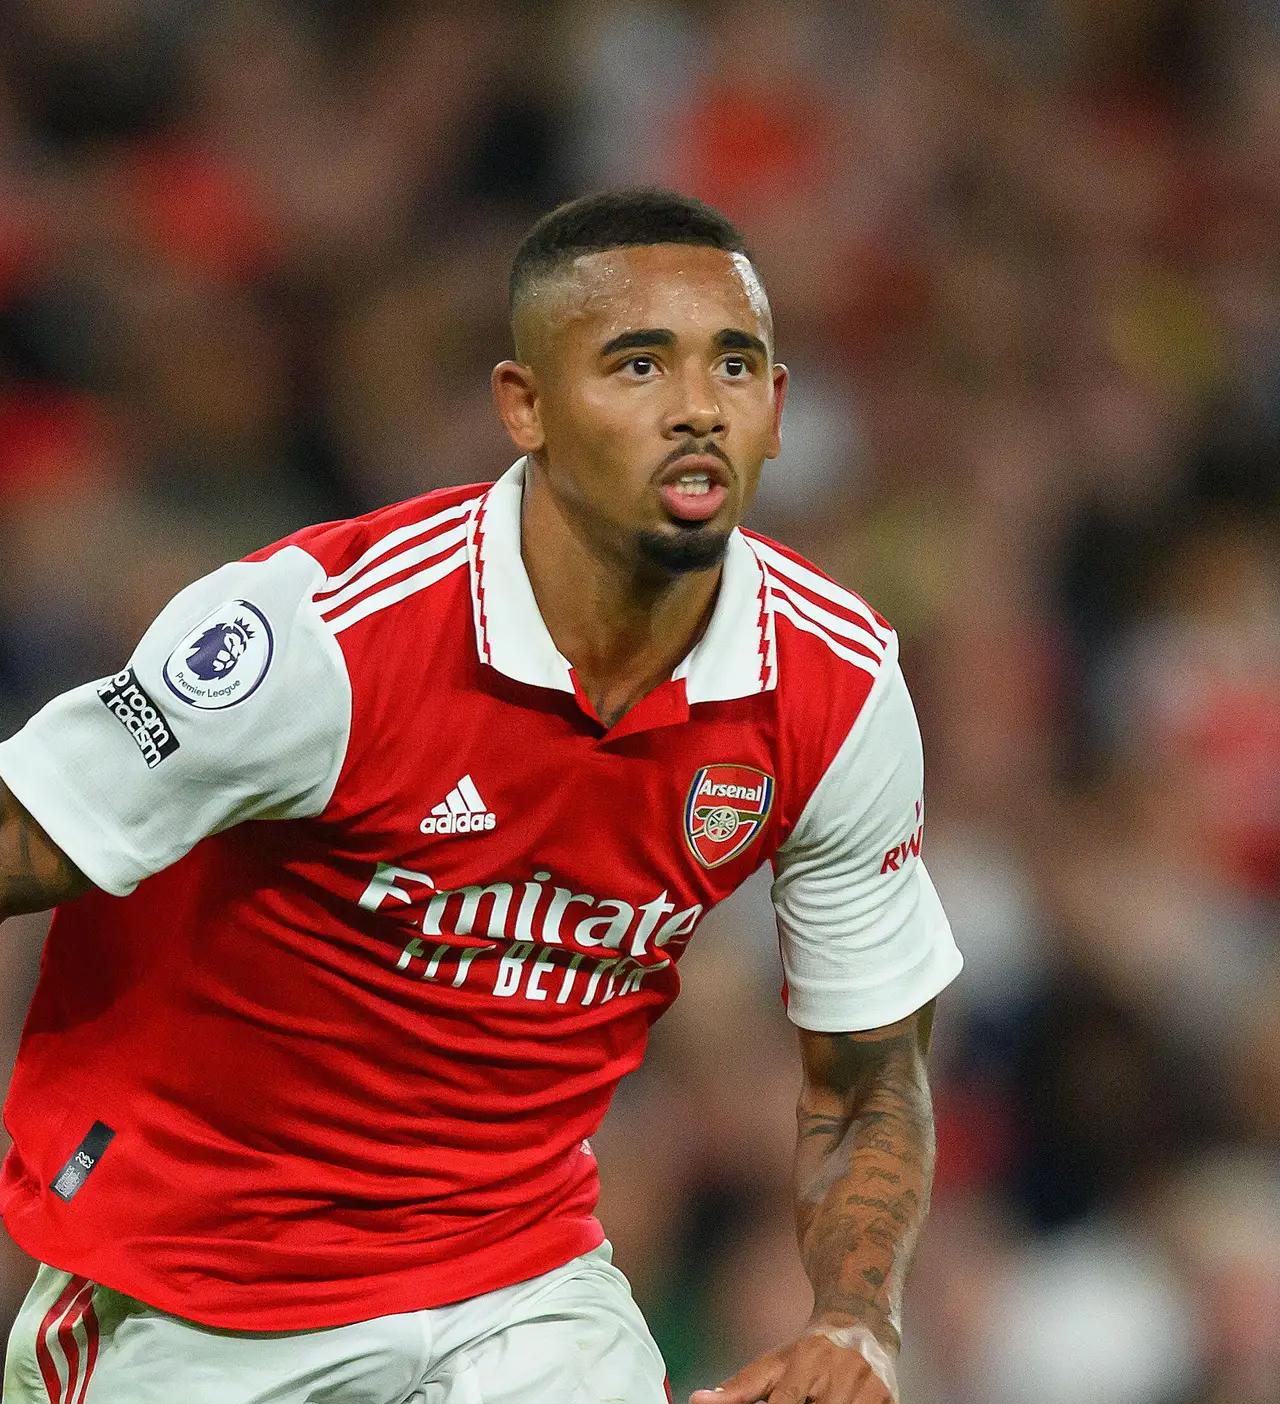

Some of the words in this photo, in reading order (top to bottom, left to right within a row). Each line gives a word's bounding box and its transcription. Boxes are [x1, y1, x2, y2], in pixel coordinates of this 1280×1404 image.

[175, 672, 205, 697] Premier
[208, 680, 241, 697] League
[107, 695, 161, 768] racism
[122, 684, 169, 748] room
[699, 779, 762, 801] Arsenal
[420, 811, 496, 835] adidas
[358, 861, 704, 957] Emirate
